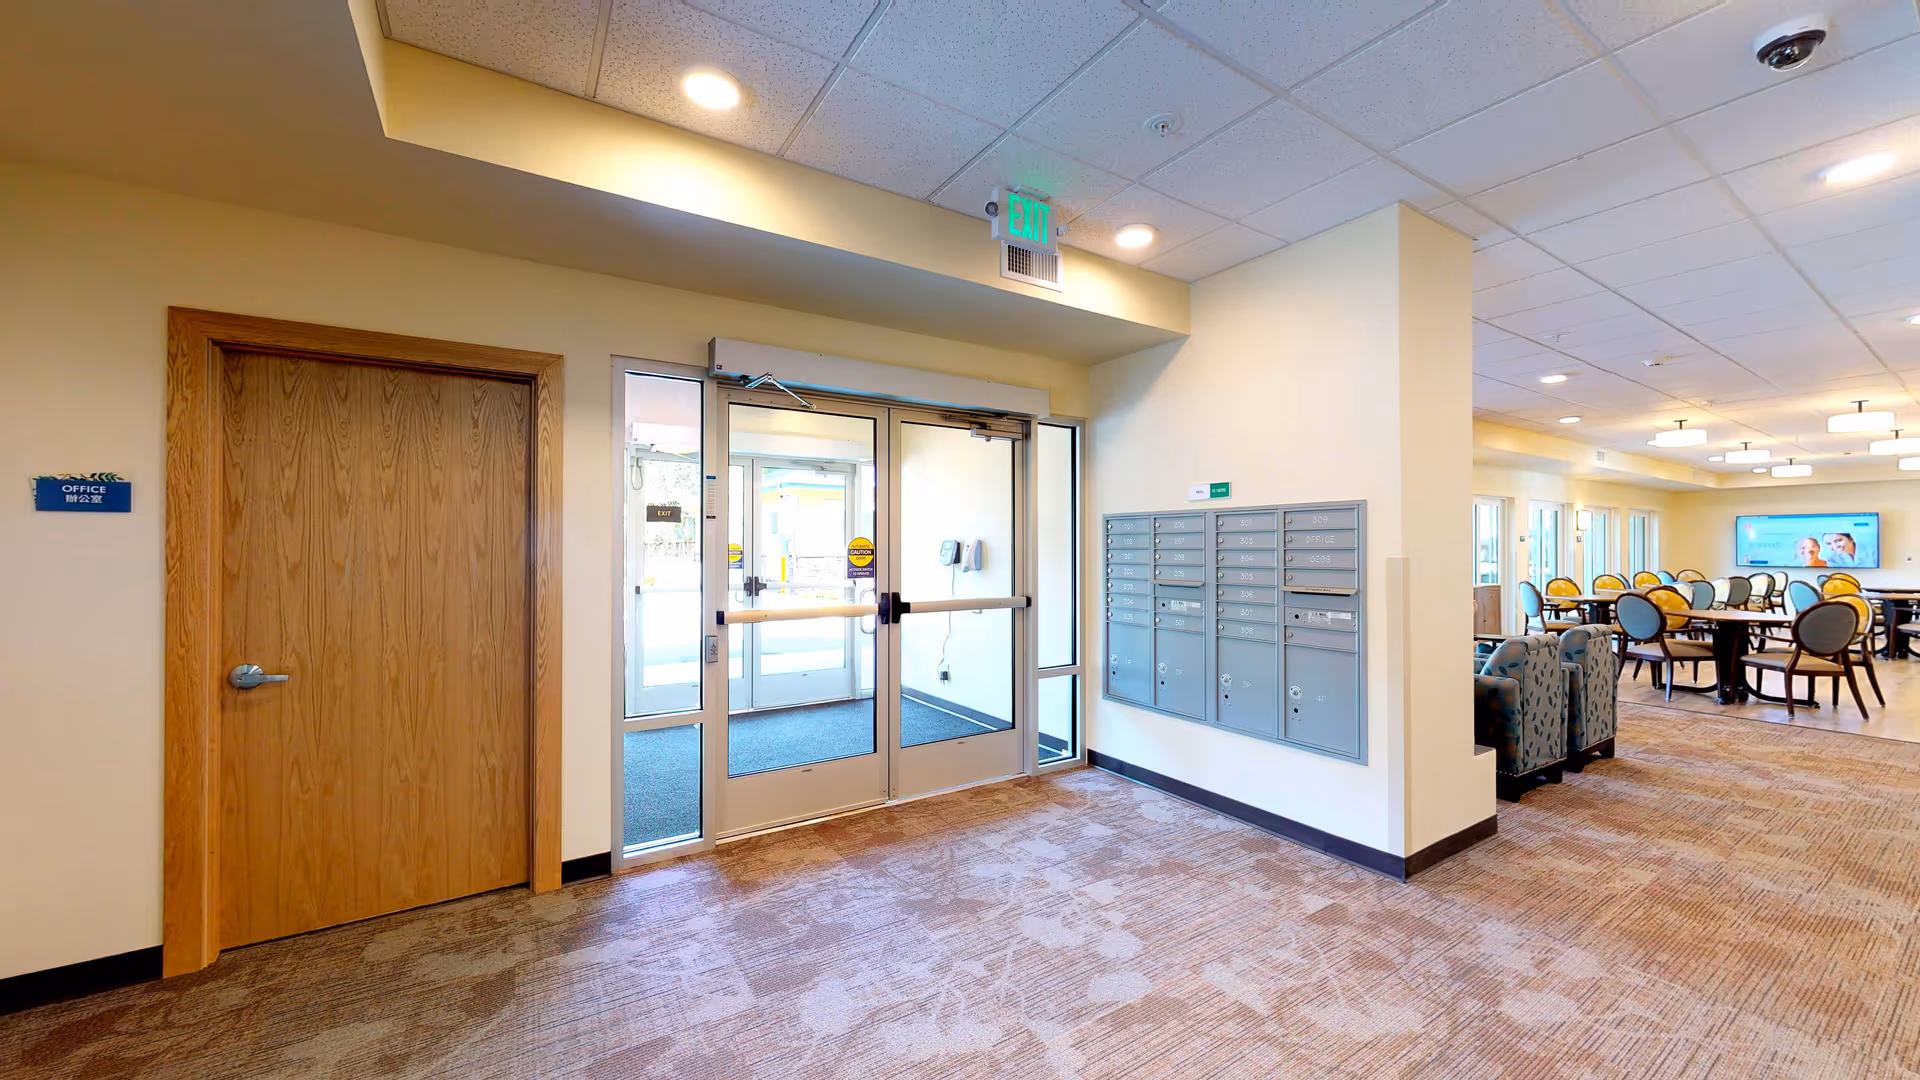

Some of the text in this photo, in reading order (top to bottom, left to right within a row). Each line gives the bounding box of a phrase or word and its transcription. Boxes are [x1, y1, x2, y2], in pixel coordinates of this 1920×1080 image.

[1008, 193, 1050, 244] EXIT
[61, 484, 107, 494] OFFICE
[65, 494, 103, 504] 辦公室
[1312, 515, 1328, 524] 309
[1305, 535, 1336, 544] OFFICE
[1240, 590, 1254, 598] 306
[1240, 608, 1254, 616] 307
